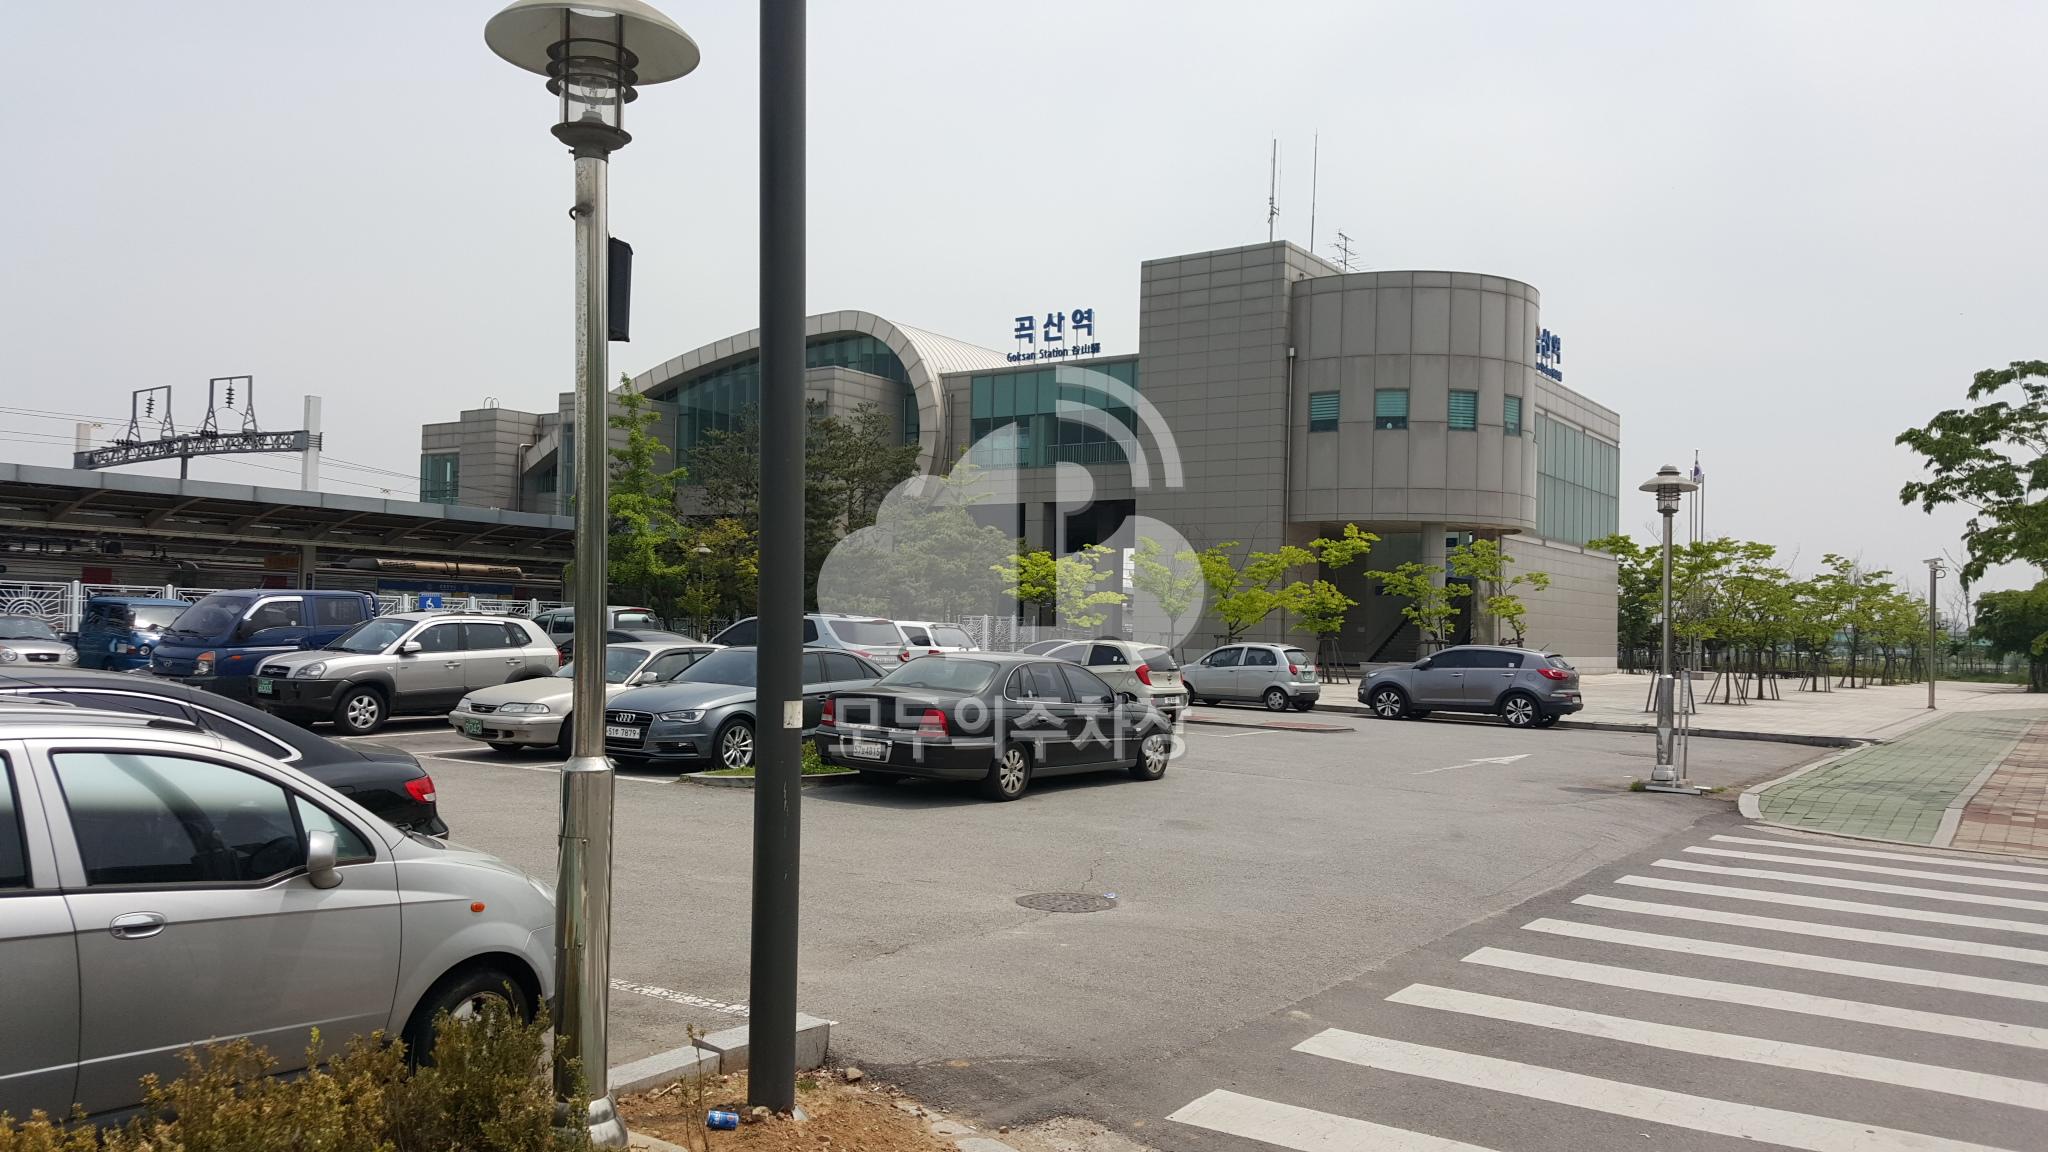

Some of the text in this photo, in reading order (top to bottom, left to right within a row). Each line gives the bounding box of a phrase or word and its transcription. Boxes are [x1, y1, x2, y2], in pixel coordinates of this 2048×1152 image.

[1014, 308, 1093, 344] 곡산역
[1006, 351, 1036, 362] Goksan
[1039, 347, 1068, 359] Station
[1536, 328, 1561, 364] 산역
